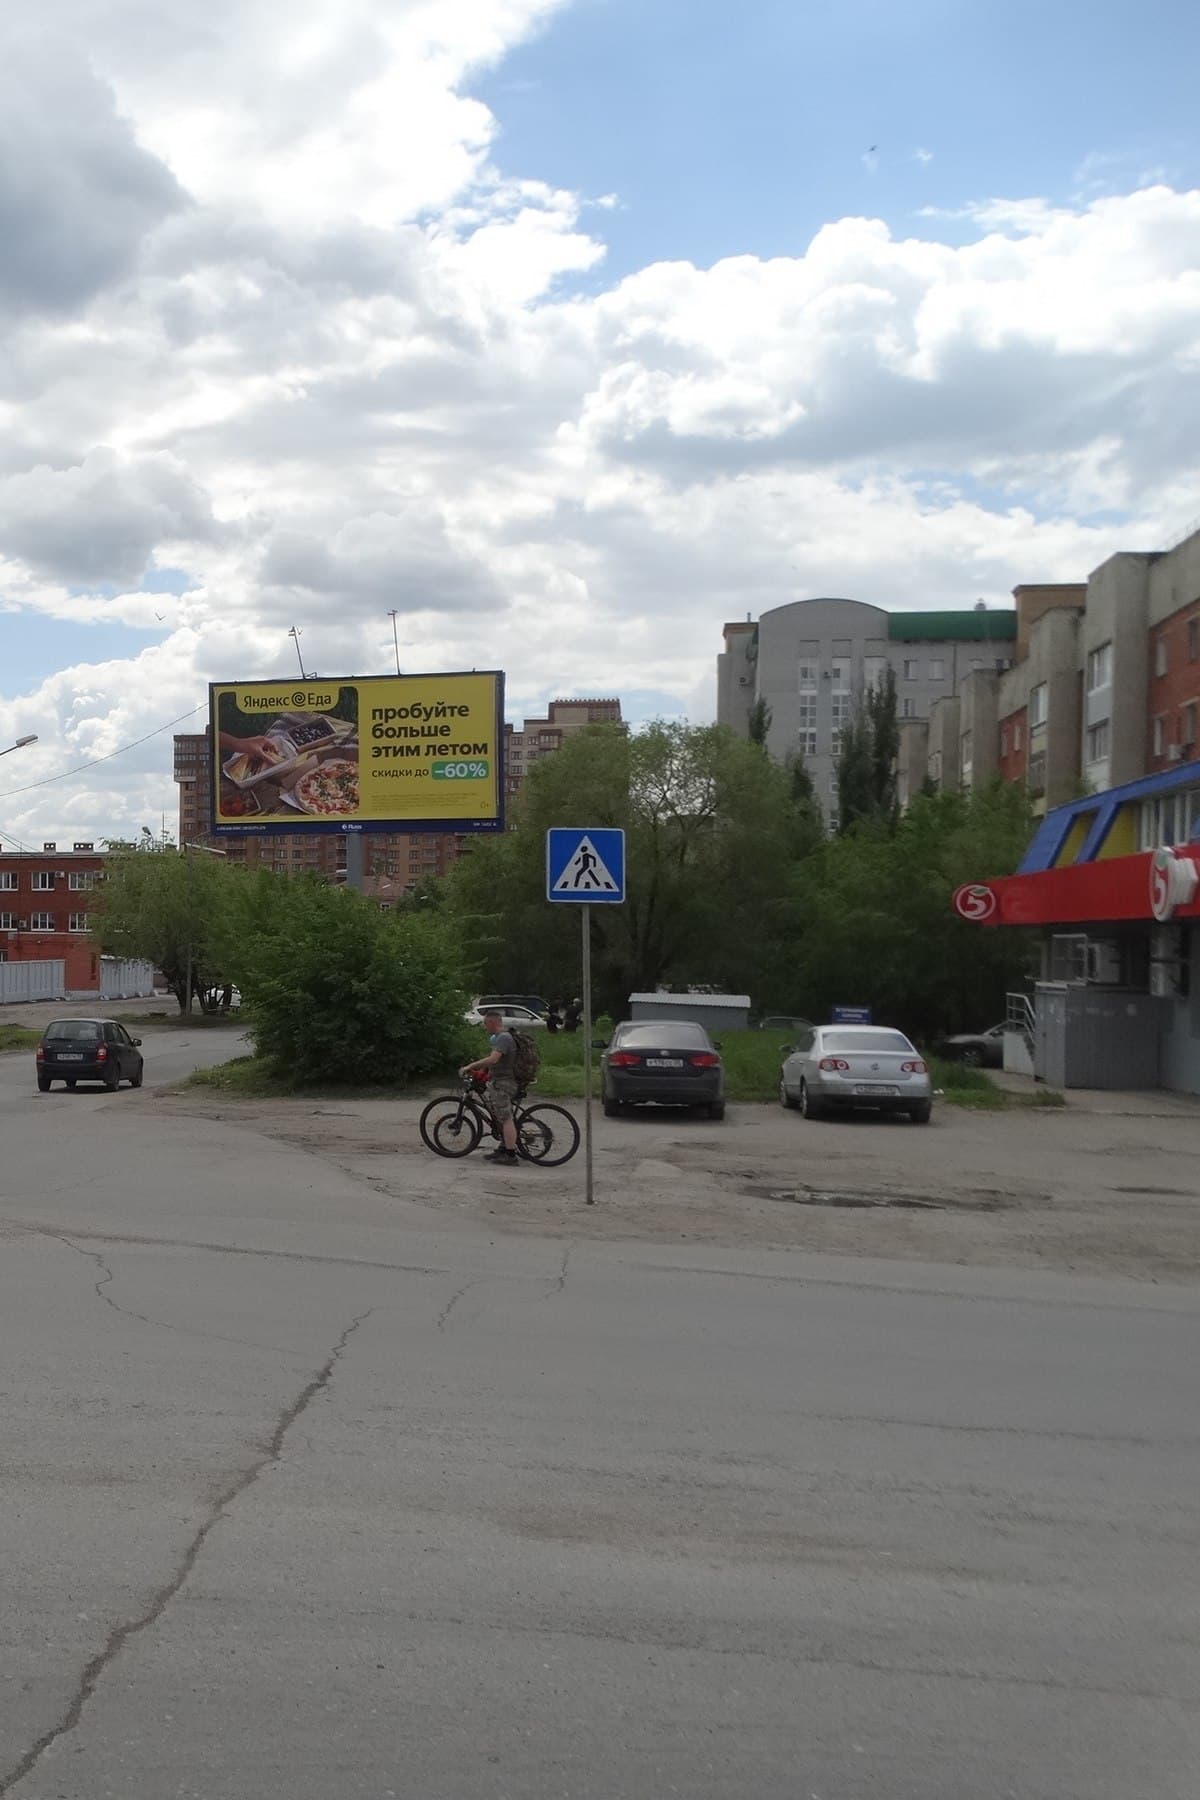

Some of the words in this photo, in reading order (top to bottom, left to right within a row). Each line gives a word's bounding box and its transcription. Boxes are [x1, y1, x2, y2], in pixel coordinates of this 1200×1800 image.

[244, 695, 290, 708] Яндекс
[307, 693, 332, 706] Еда
[371, 701, 470, 723] пробуйте
[371, 723, 451, 739] больше
[371, 745, 421, 758] этим
[424, 743, 488, 757] летом
[371, 769, 413, 778] скидки
[414, 768, 430, 777] до
